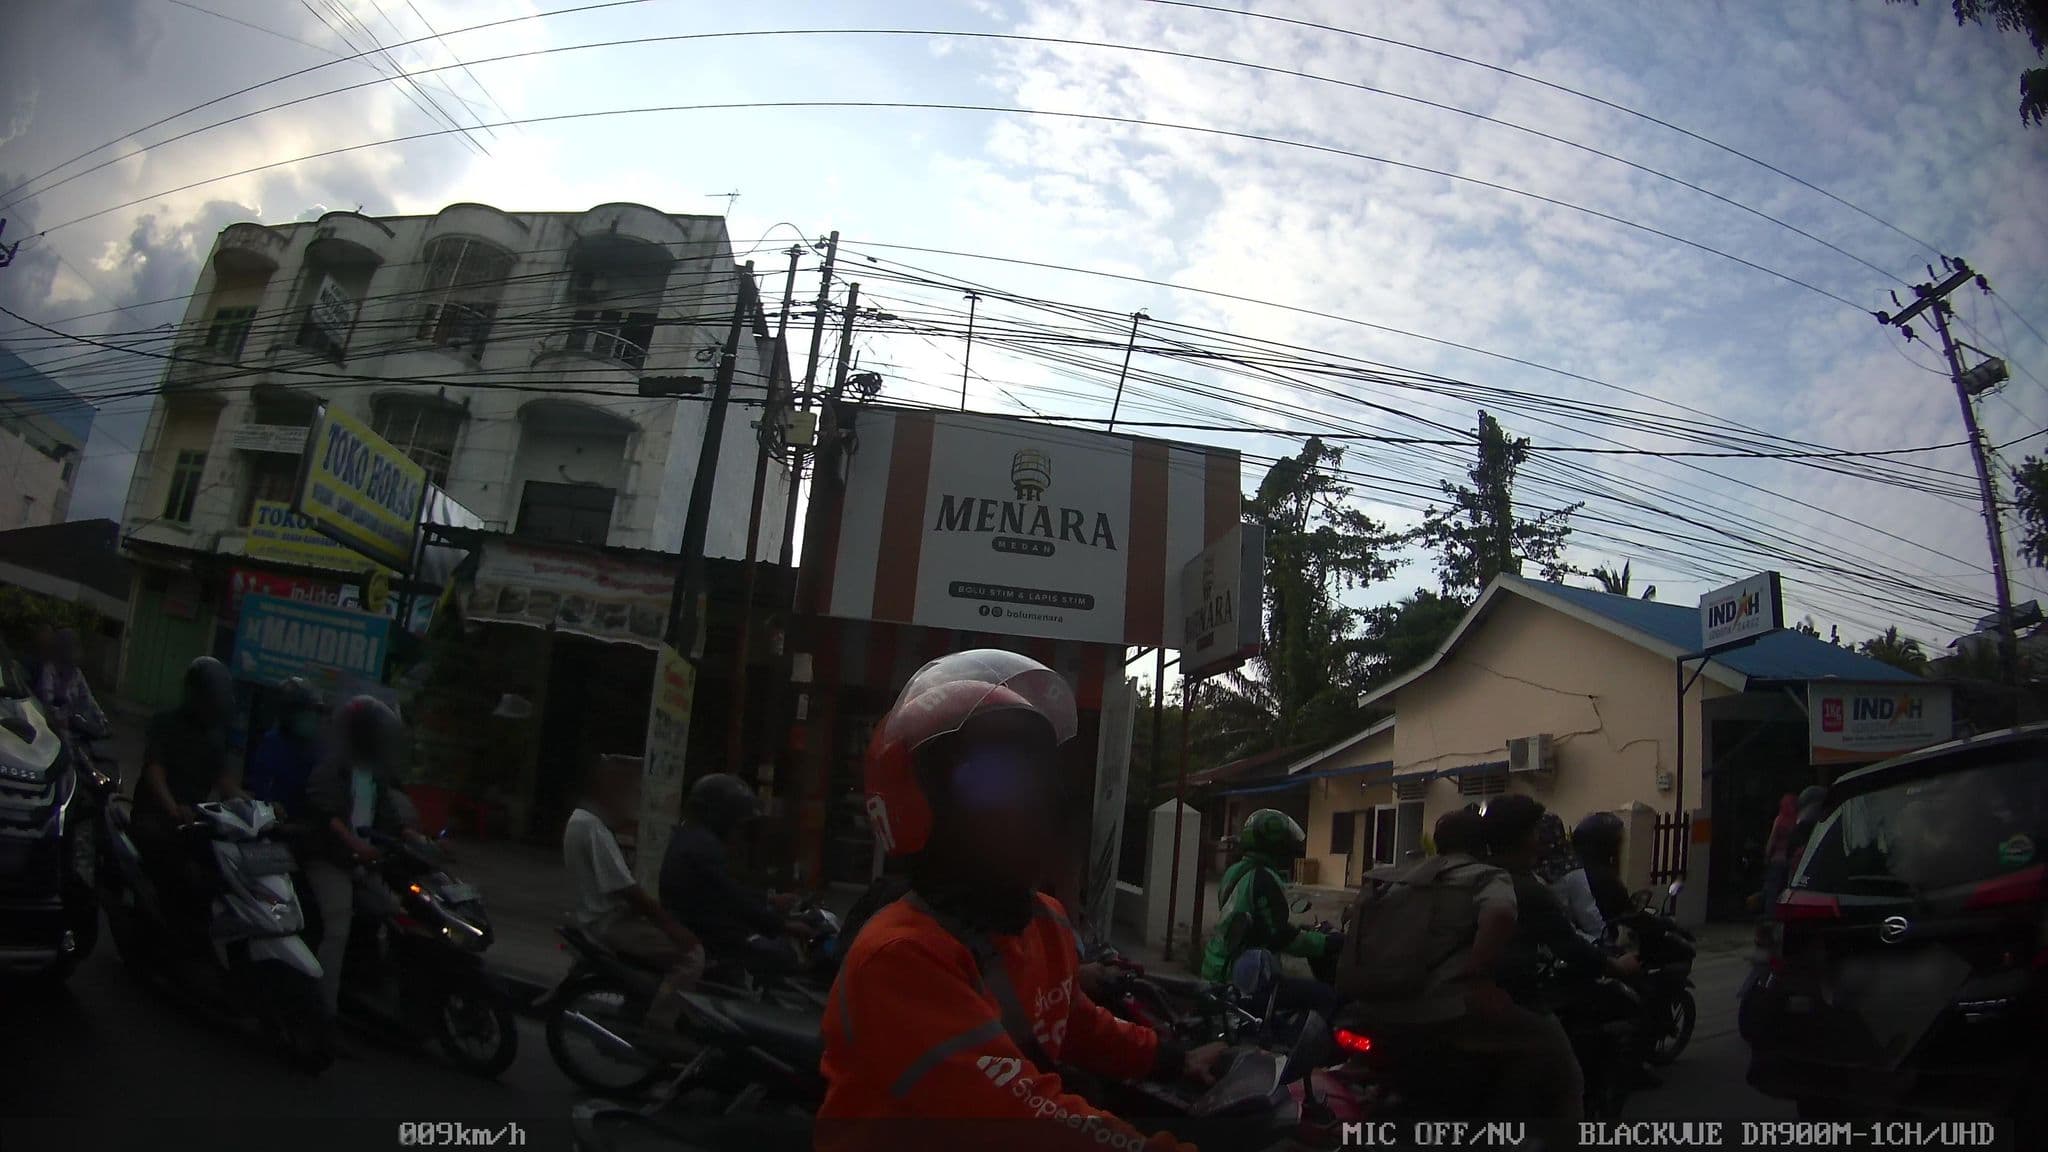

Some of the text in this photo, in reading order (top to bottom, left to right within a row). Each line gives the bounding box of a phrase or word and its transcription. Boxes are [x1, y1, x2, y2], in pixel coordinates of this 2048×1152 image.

[323, 422, 369, 490] TOKO
[933, 494, 1118, 551] MENARA
[997, 540, 1051, 553] MEDAN
[958, 585, 985, 596] BOLU
[989, 589, 1015, 600] STIM
[1029, 592, 1058, 603] LAPIS
[1062, 596, 1087, 606] STIM
[1006, 609, 1064, 624] bolumenara
[261, 615, 380, 673] MANDIRI
